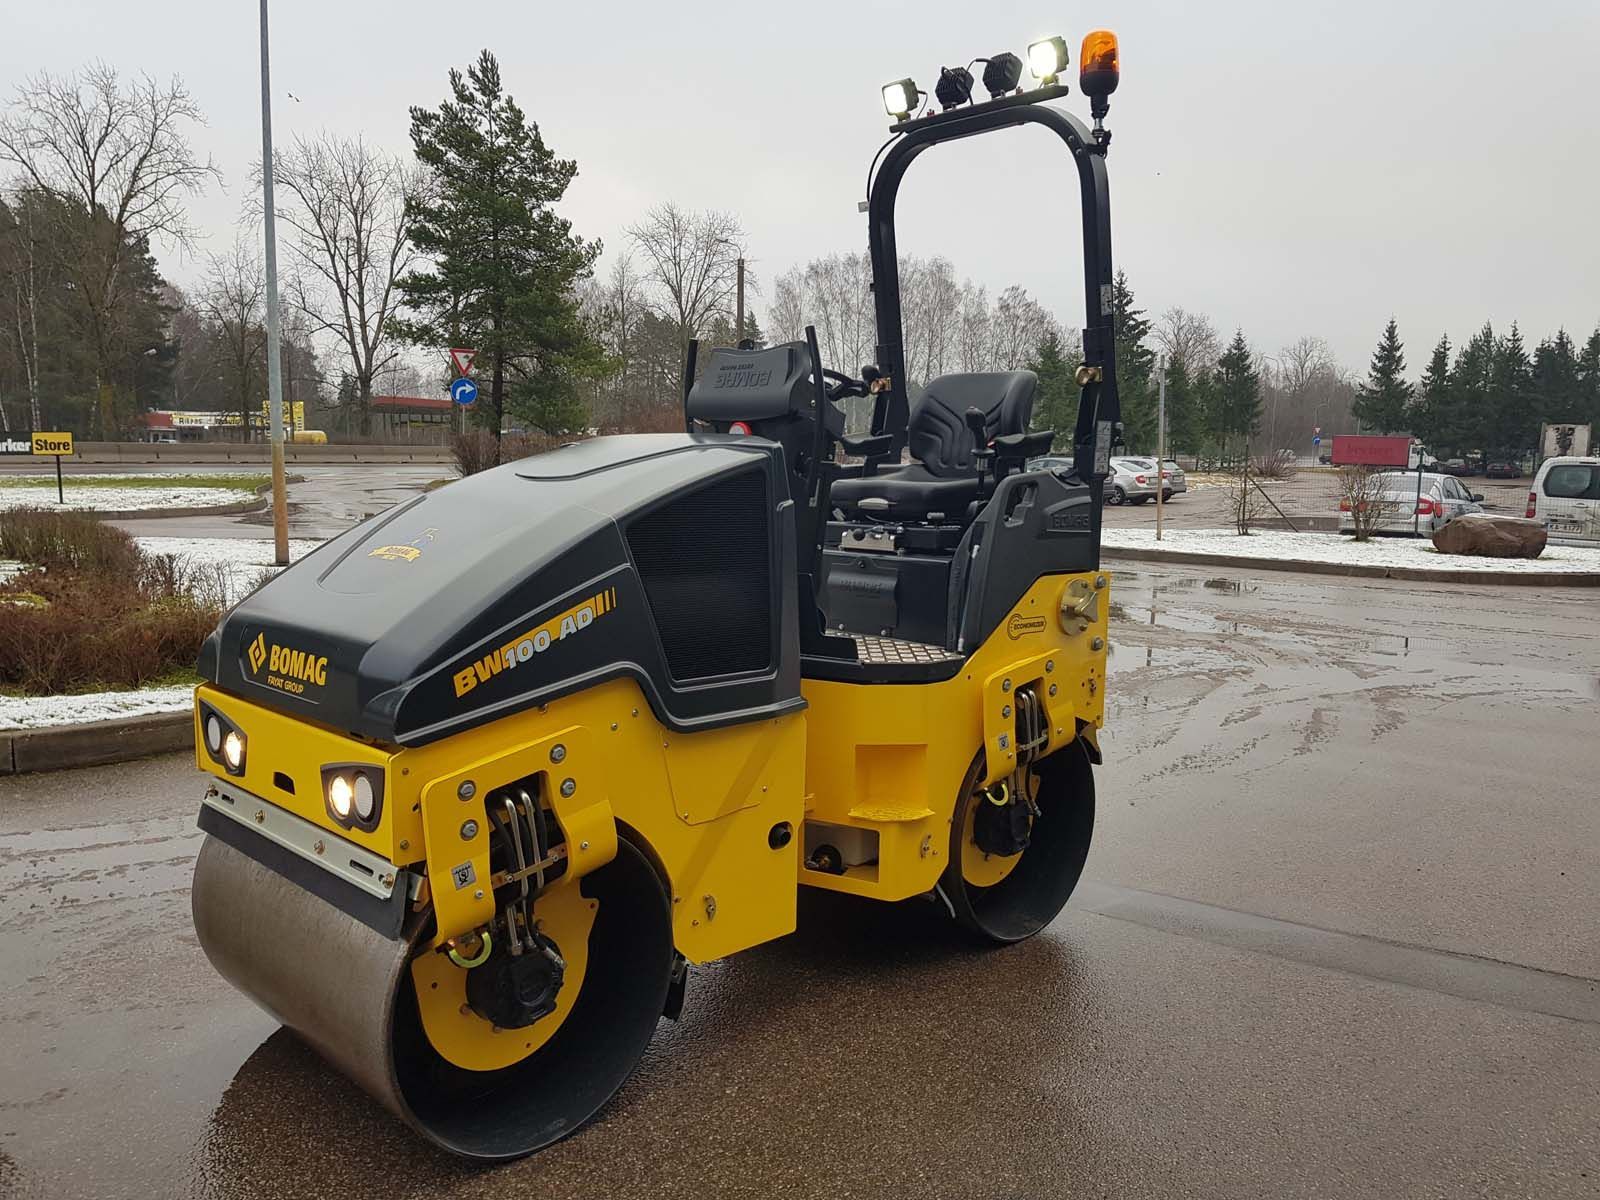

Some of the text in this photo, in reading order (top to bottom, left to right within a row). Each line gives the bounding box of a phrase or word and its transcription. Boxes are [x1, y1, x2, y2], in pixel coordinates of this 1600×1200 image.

[0, 438, 70, 452] rker Store
[559, 606, 594, 641] AD
[269, 644, 328, 686] BOMAG
[267, 675, 304, 694] FAYAT GROUP
